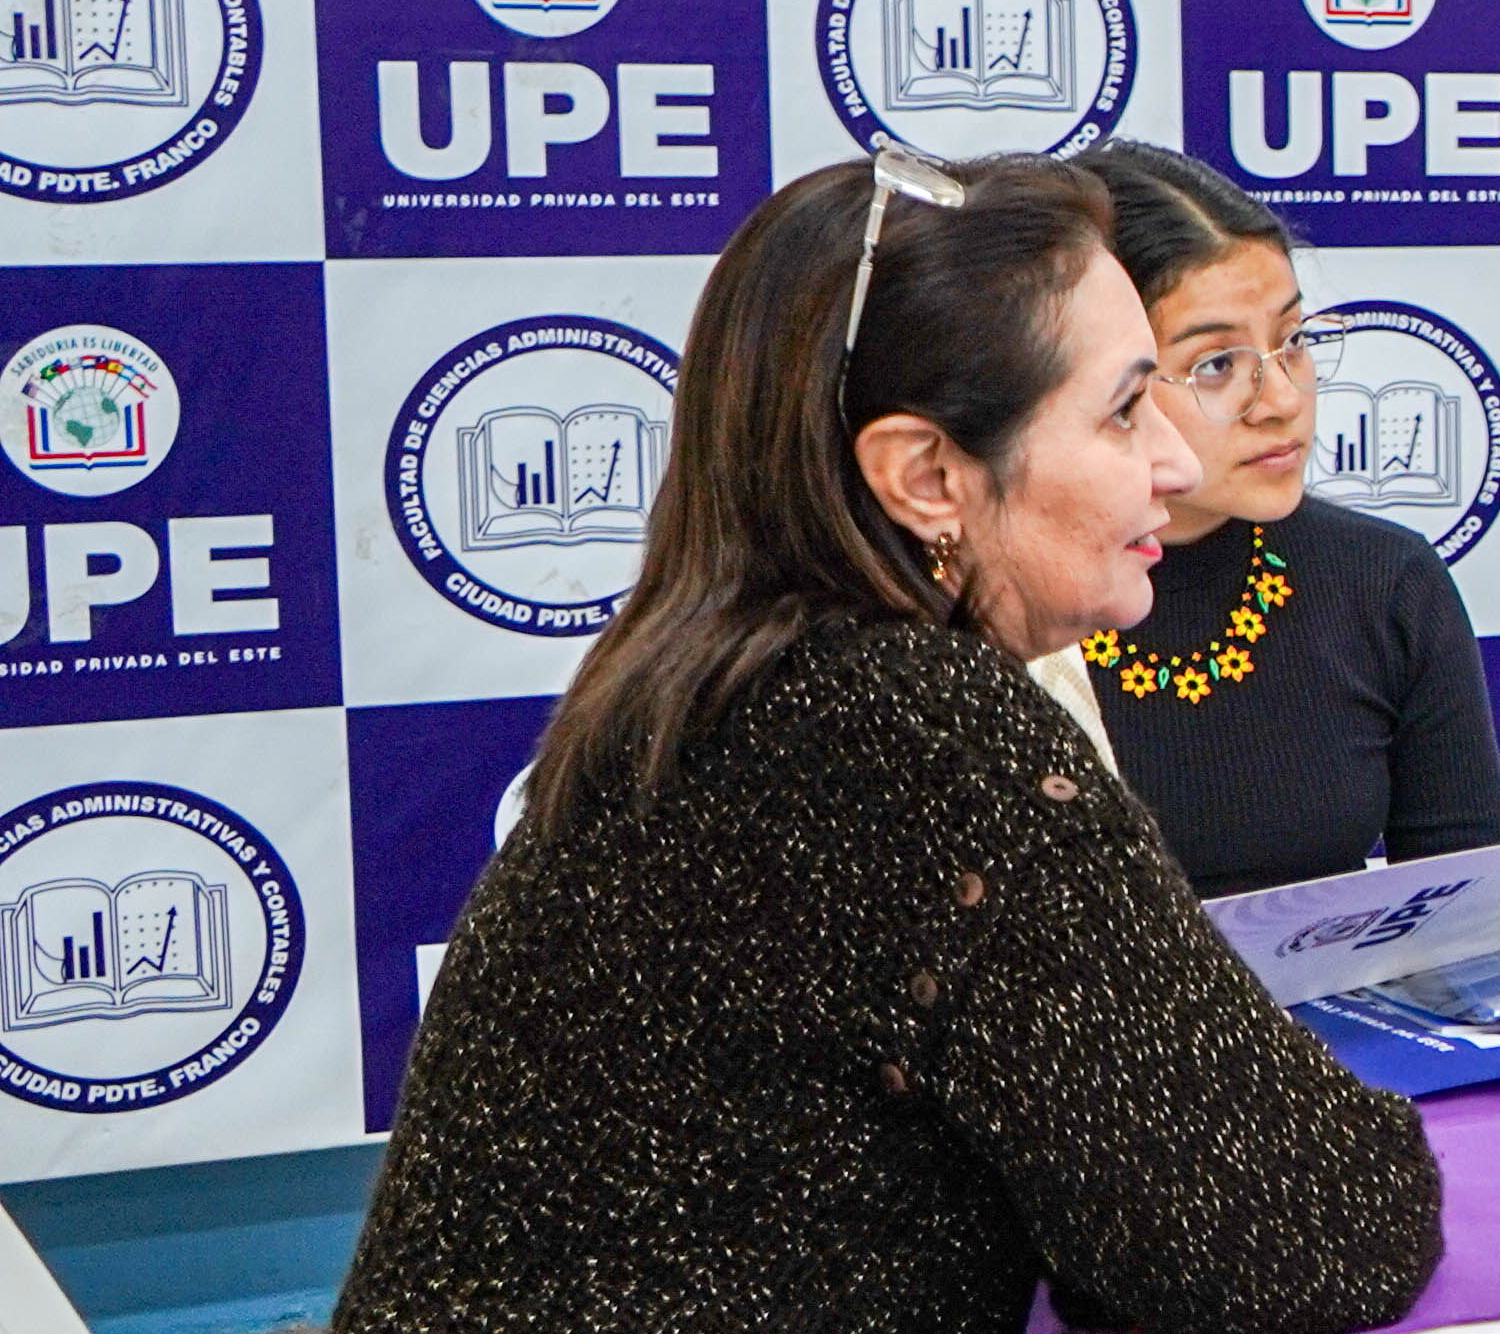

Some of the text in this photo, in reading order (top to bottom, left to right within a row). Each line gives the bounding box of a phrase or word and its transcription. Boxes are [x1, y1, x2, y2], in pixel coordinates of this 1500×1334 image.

[38, 115, 219, 191] PDTE. FRANCO
[375, 60, 719, 179] UPE
[381, 194, 720, 207] UNIVERSIDAD PRIVADA DEL ESTE
[11, 337, 158, 380] SABIDURIA ES LIBERTAD
[73, 647, 282, 671] PRIVADA DEL ESTE
[46, 790, 290, 1003] ADMINISTRATIVAS Y CONTABLES
[1353, 878, 1474, 951] UPE
[87, 1012, 262, 1098] PDTE. FRANCO
